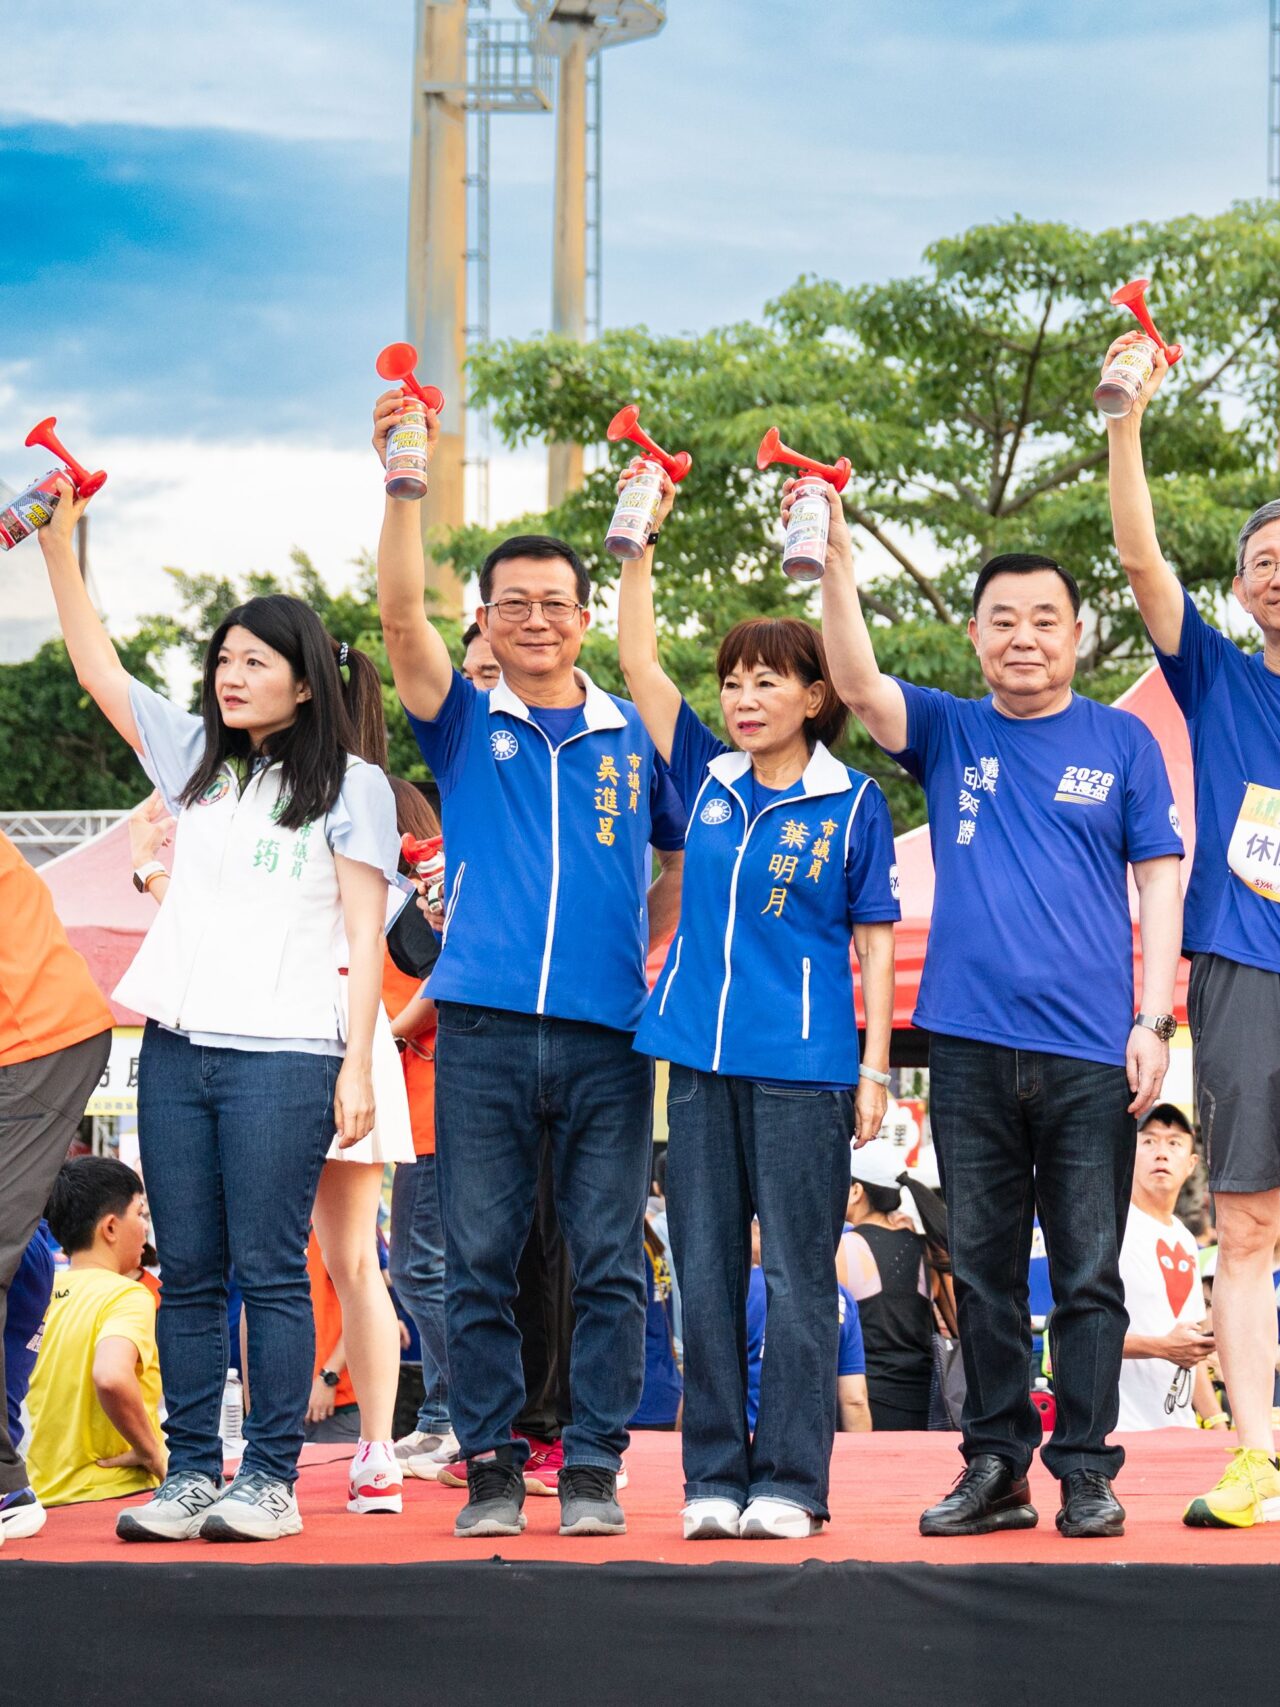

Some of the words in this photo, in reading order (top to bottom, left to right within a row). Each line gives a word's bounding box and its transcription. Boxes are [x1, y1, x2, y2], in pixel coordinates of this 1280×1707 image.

[594, 754, 621, 847] 吳進昌
[626, 752, 642, 814] 市議員
[1062, 765, 1115, 788] 2026
[760, 819, 811, 918] 葉明月
[805, 818, 838, 884] 市議員
[1254, 878, 1274, 890] SYM
[53, 1288, 70, 1299] ILA
